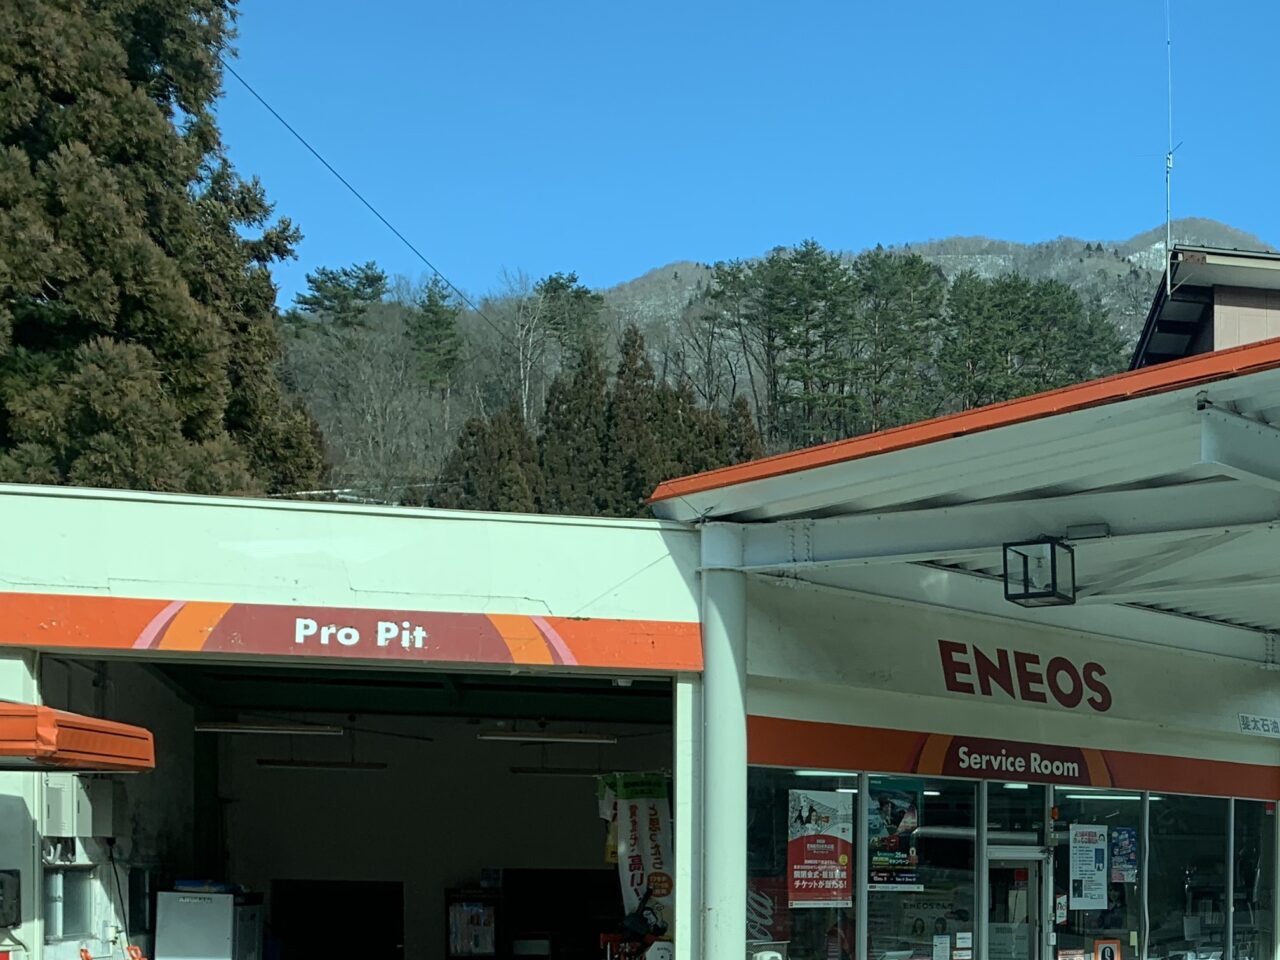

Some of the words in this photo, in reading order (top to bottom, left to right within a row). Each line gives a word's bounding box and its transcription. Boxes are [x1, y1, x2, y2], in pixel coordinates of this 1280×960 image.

[295, 617, 360, 646] Pro
[377, 621, 427, 648] Pit
[938, 639, 1112, 712] ENEOS
[958, 746, 1026, 773] Service
[1030, 752, 1079, 777] Room
